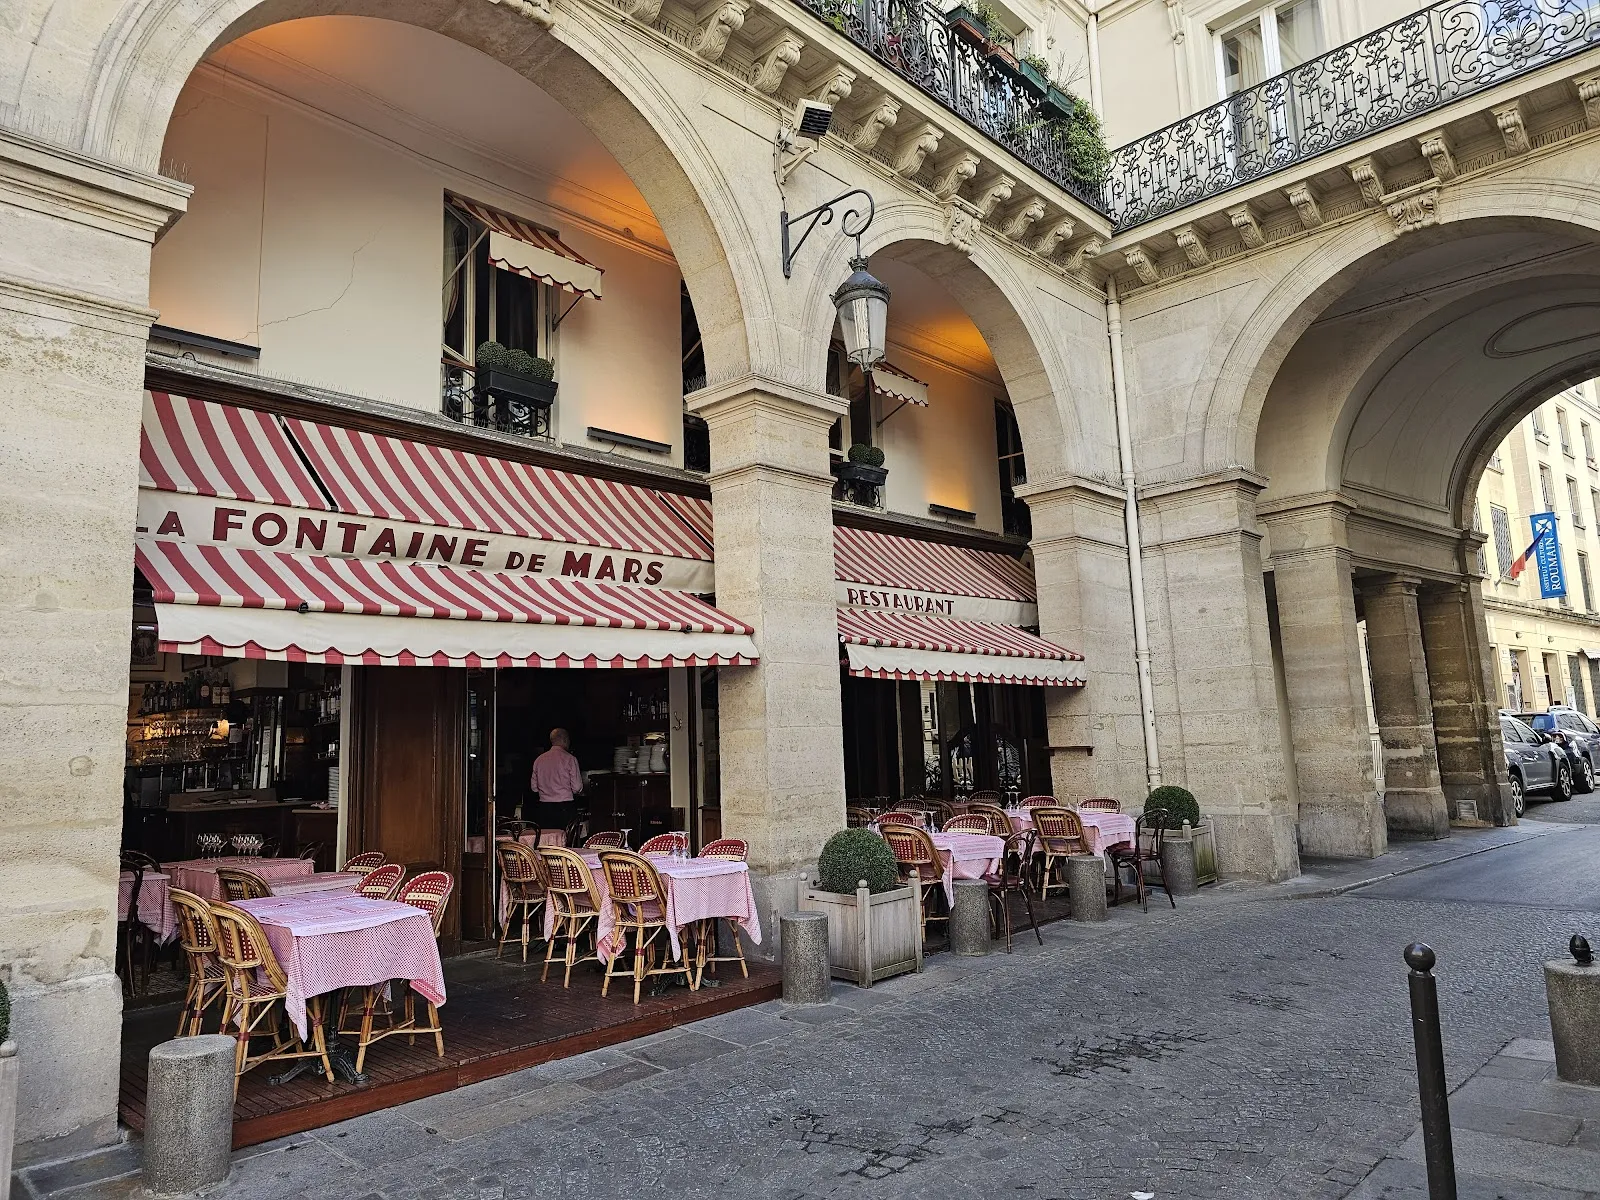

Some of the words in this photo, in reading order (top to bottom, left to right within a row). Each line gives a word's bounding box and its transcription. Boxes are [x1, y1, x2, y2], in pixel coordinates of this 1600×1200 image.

[212, 507, 490, 567] FONTAINE
[504, 551, 546, 573] DE
[560, 550, 664, 585] MARS
[1545, 537, 1561, 590] ROUMAIN
[847, 588, 955, 615] RESTAURANT
